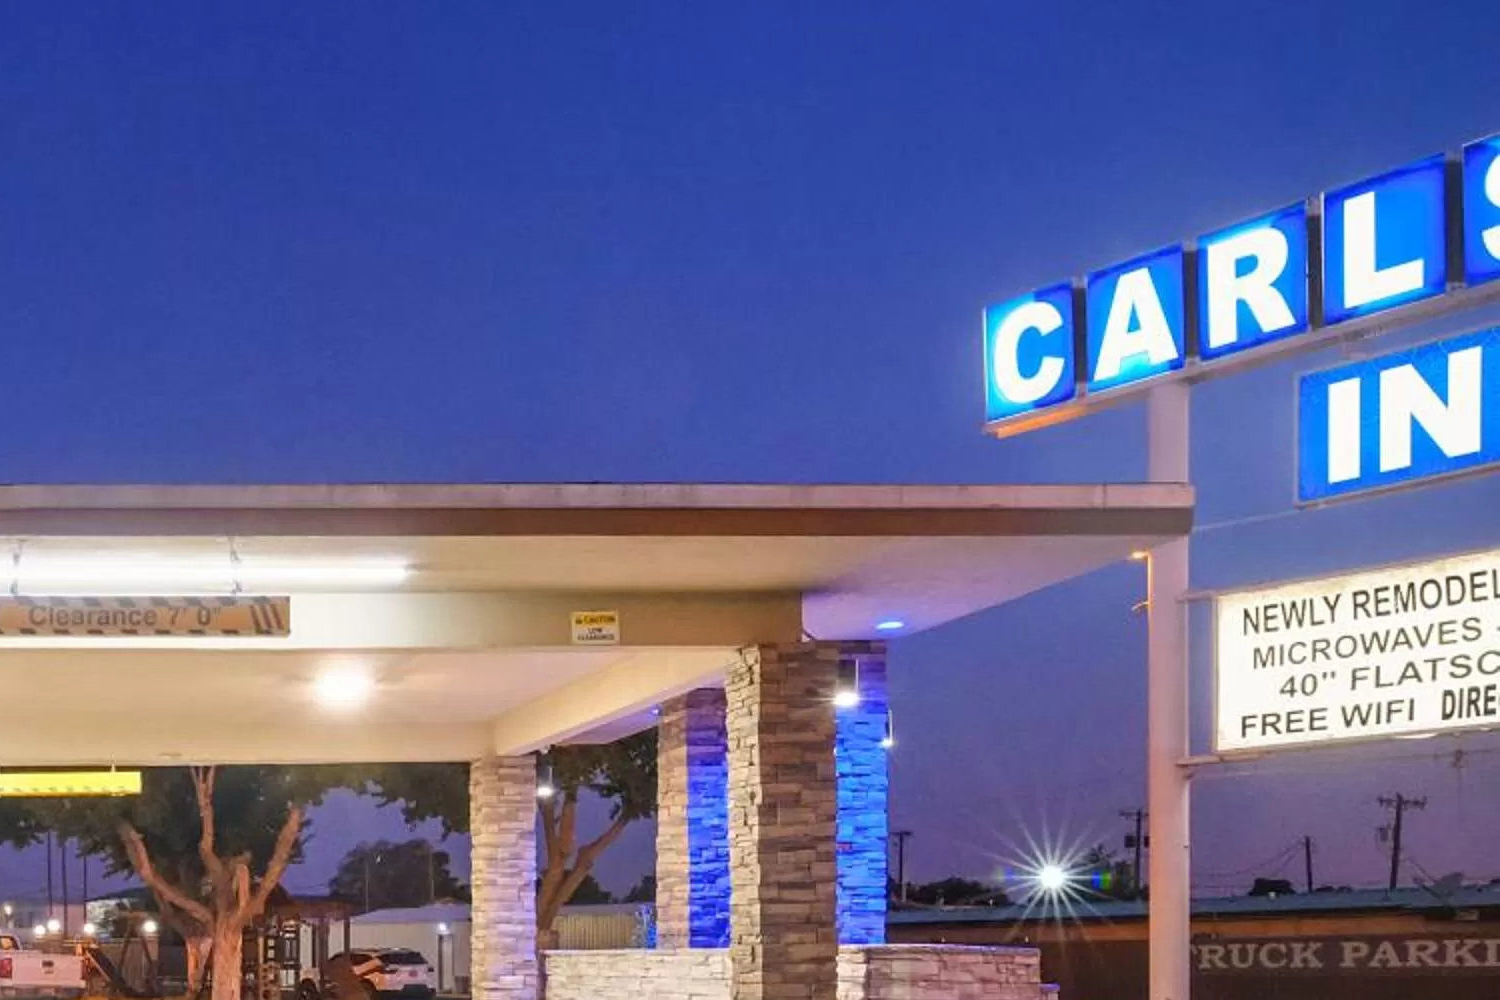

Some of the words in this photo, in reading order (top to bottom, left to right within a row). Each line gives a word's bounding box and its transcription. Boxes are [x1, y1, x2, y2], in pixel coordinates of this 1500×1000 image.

[1327, 345, 1483, 485] IN
[28, 604, 157, 627] Clearance
[1243, 593, 1342, 636] NEWLY
[1352, 568, 1500, 620] REMODEL
[1253, 616, 1482, 669] MICROWAVES
[1279, 670, 1337, 698] 40"
[1350, 650, 1500, 690] FLATSC
[1241, 707, 1328, 738] FREE
[1341, 697, 1415, 728] WIFI
[1441, 683, 1500, 720] DIRE
[1339, 938, 1500, 968] PARKI
